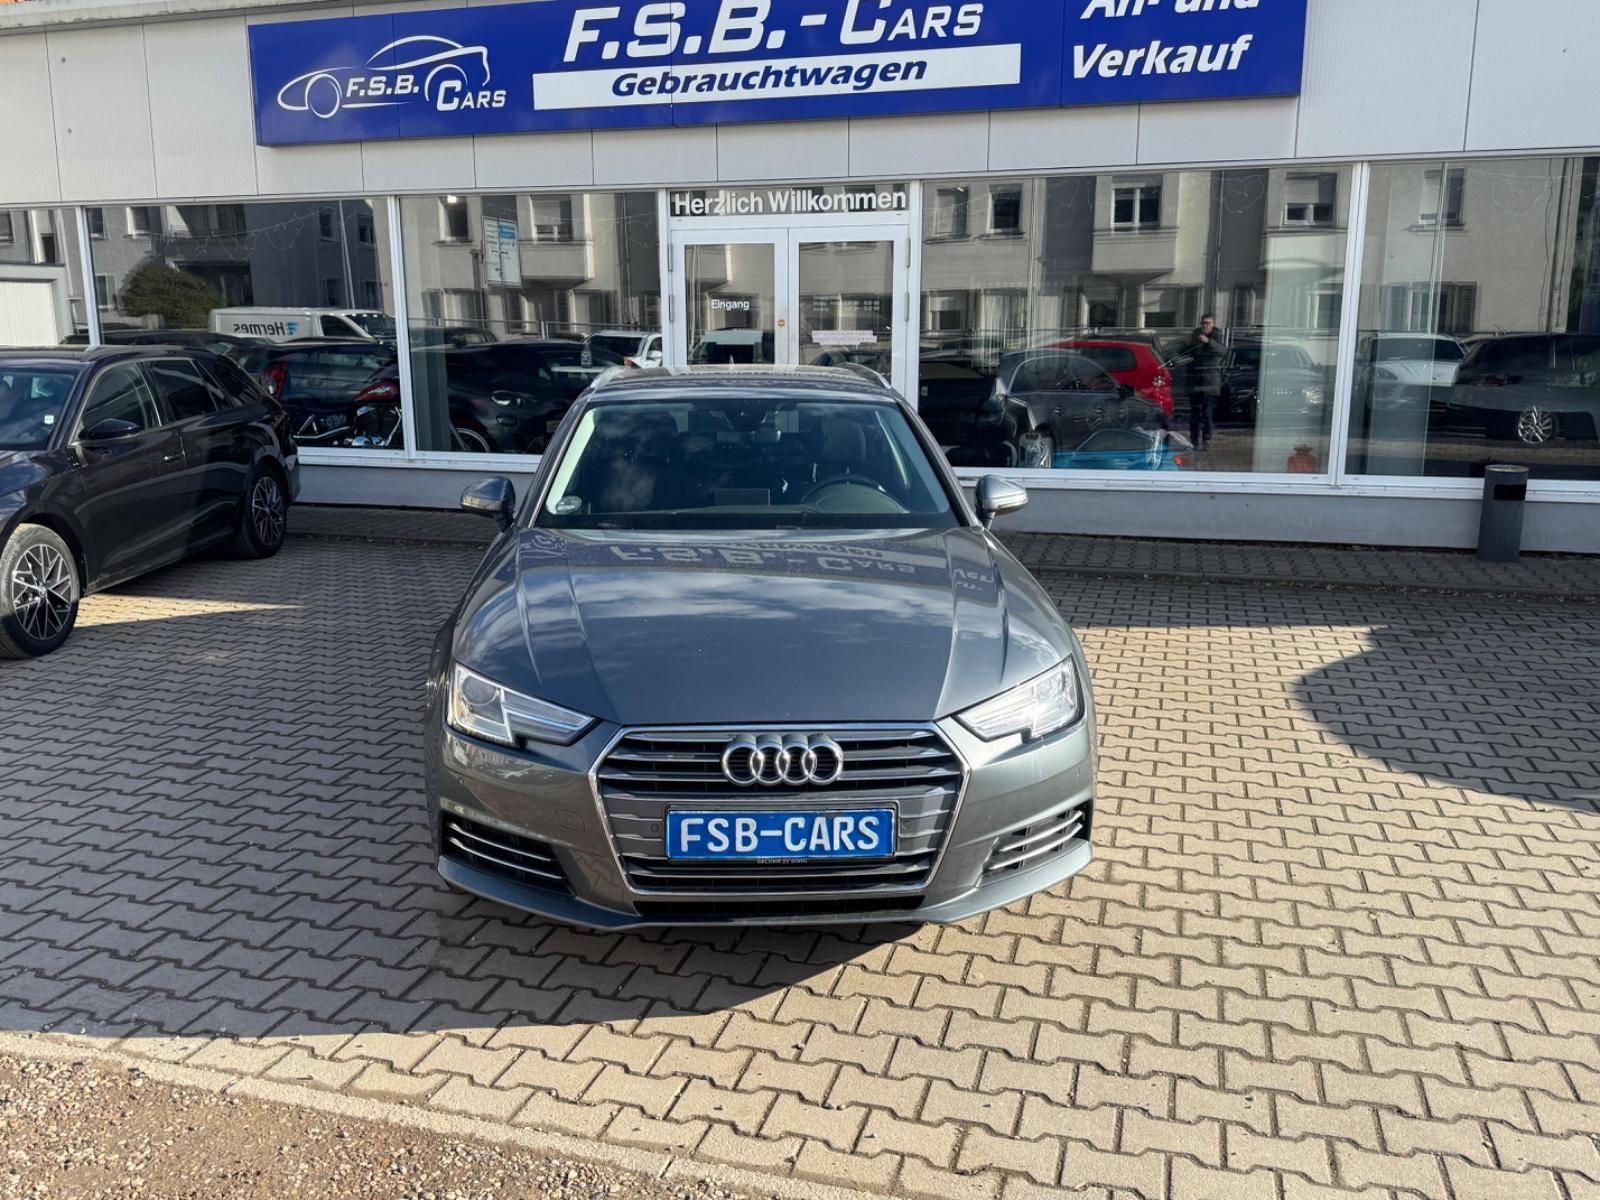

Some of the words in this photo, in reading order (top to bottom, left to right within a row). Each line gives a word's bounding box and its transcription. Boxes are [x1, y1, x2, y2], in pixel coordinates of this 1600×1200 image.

[563, 0, 786, 62] F.S.B.
[1073, 34, 1254, 79] Verkauf
[346, 75, 419, 97] F.S.B.
[612, 60, 928, 97] Gebrauchtwagen
[674, 190, 764, 216] Herzlich
[767, 188, 907, 212] Willkommen
[711, 299, 750, 311] Eingang
[680, 816, 880, 853] FSB-CARS
